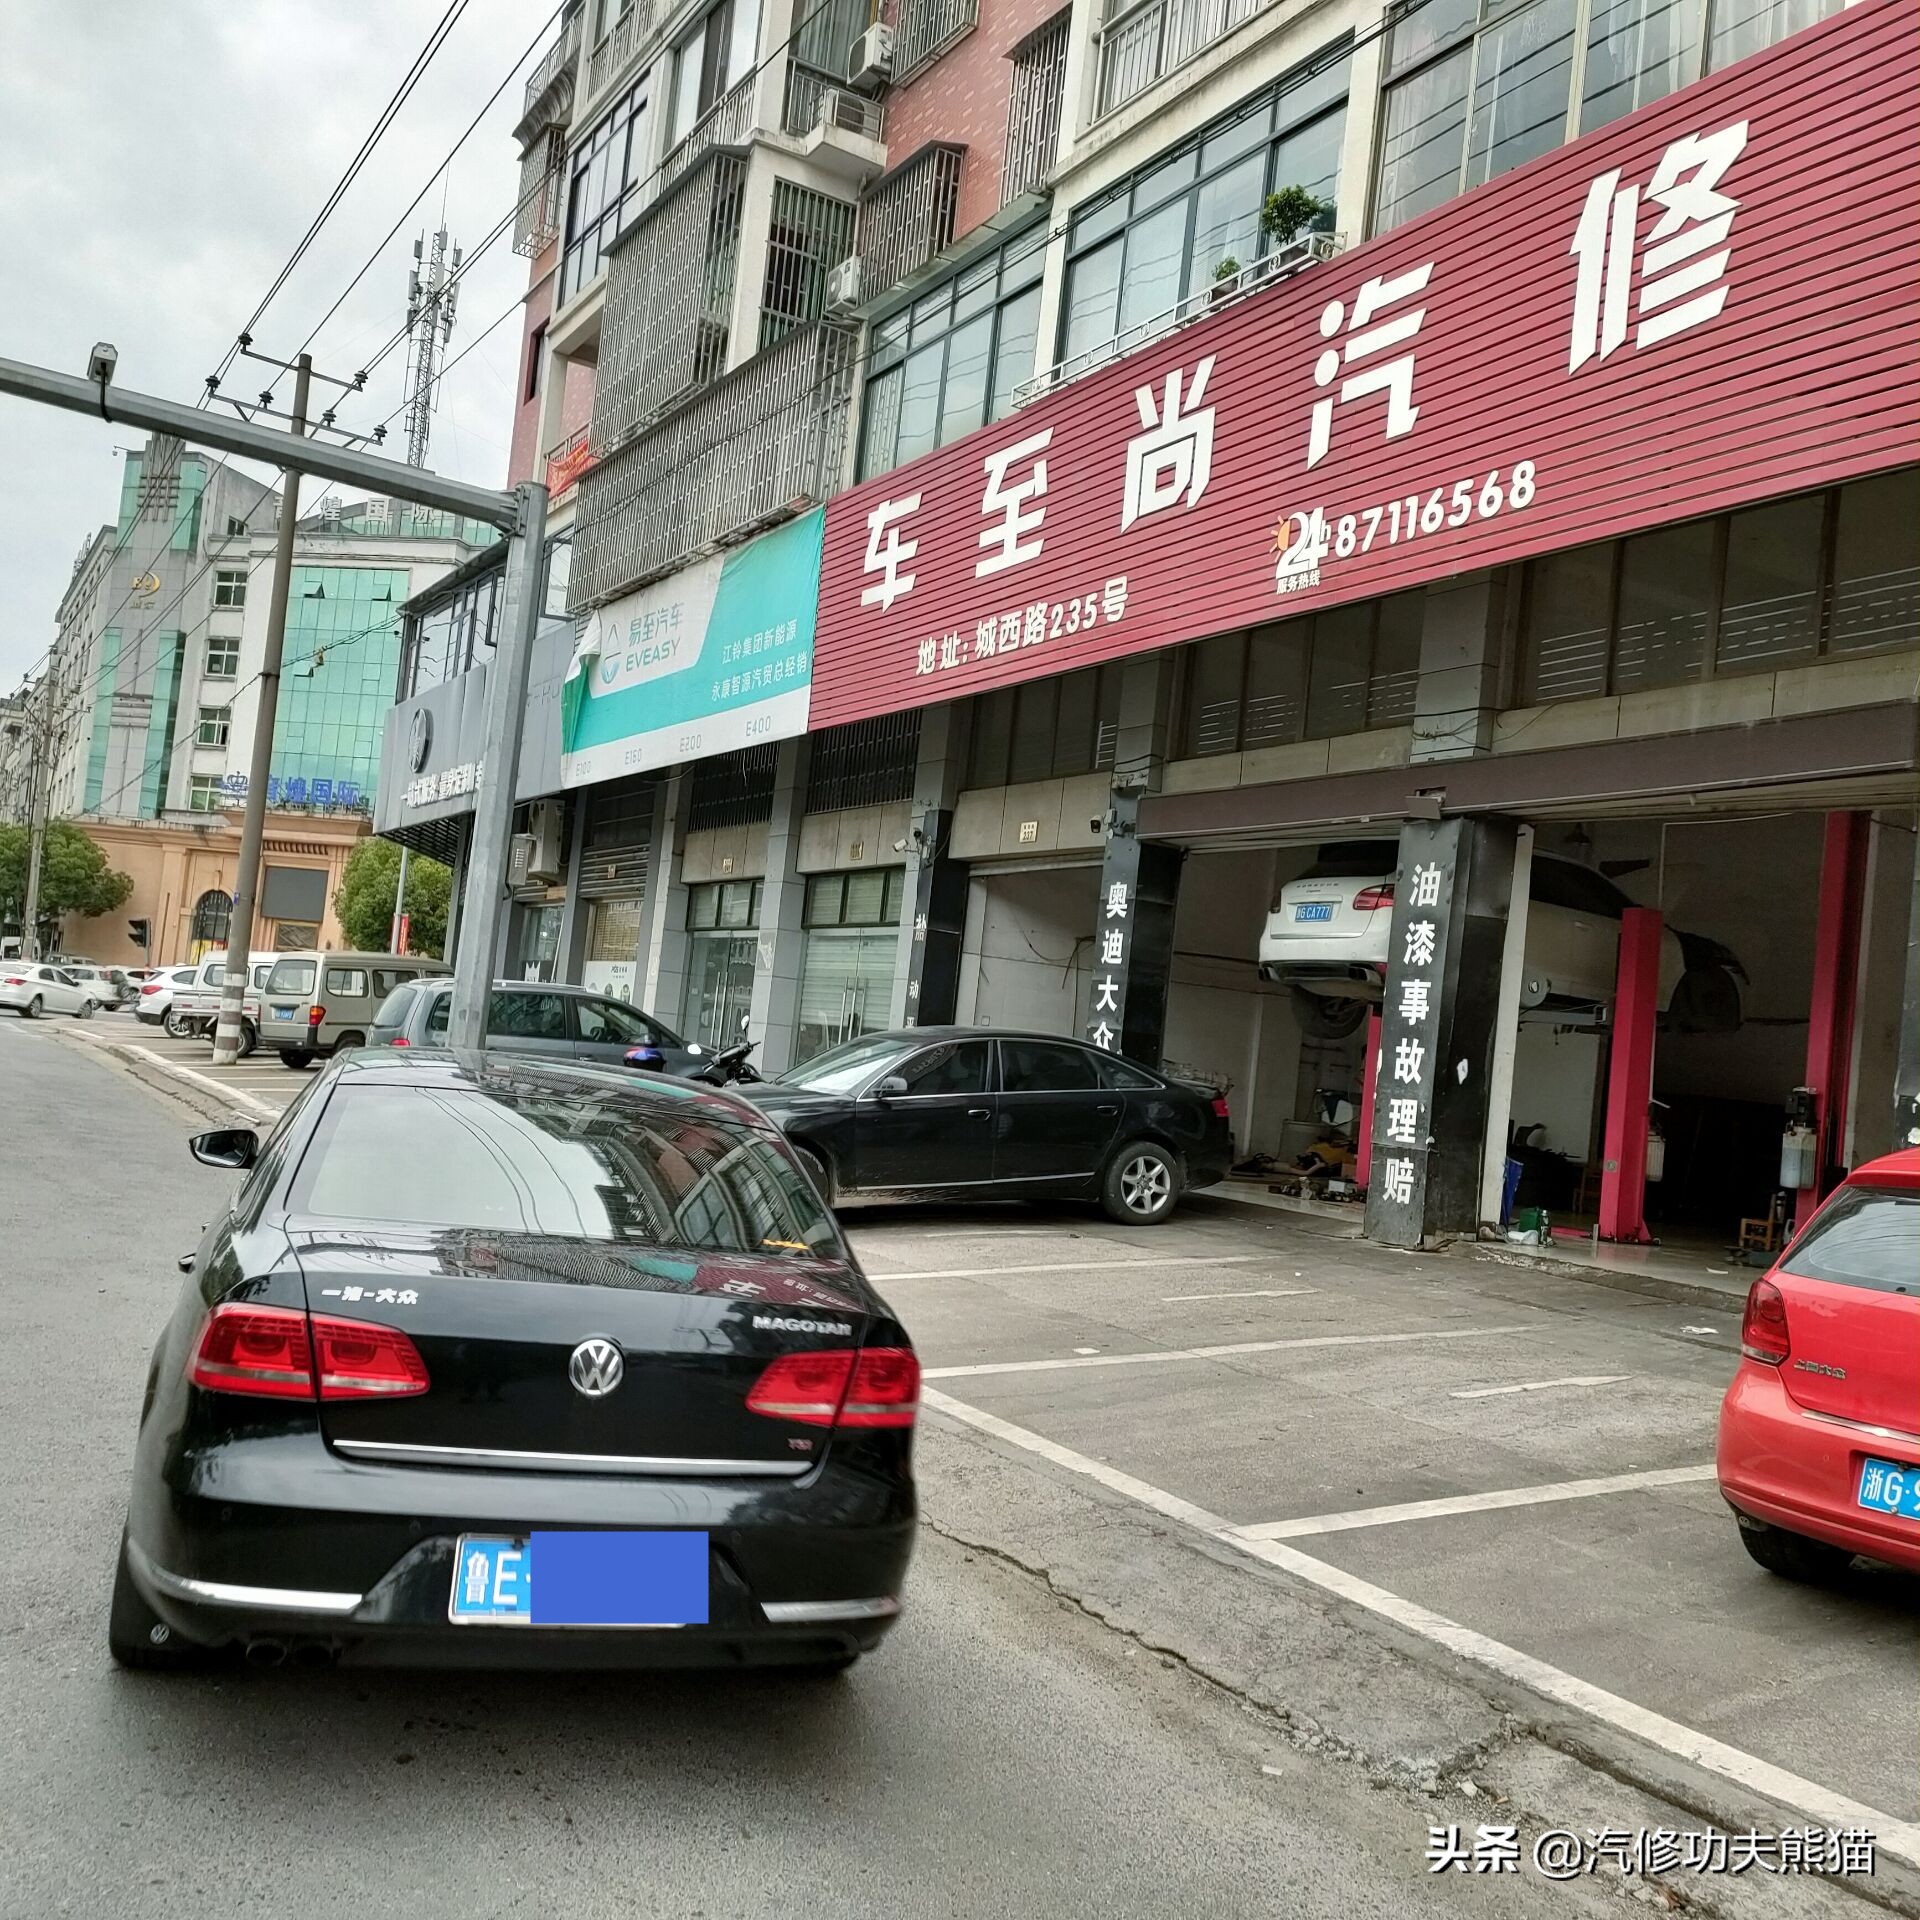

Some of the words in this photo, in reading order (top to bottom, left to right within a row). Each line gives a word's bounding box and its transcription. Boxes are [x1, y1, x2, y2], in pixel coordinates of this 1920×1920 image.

[861, 118, 1750, 614] 车至尚汽修
[1335, 460, 1537, 558] 87116568
[1276, 569, 1321, 595] 服务热线
[628, 601, 685, 648] 易至汽车
[722, 618, 798, 665] 江铃集团新能源
[625, 636, 682, 673] EVEASY
[711, 649, 808, 703] 永康智源汽贸总经销
[679, 734, 702, 753] E200
[745, 715, 773, 738] E400
[1382, 861, 1442, 1206] 油漆事故理赔
[752, 1315, 852, 1337] MAGOTAN
